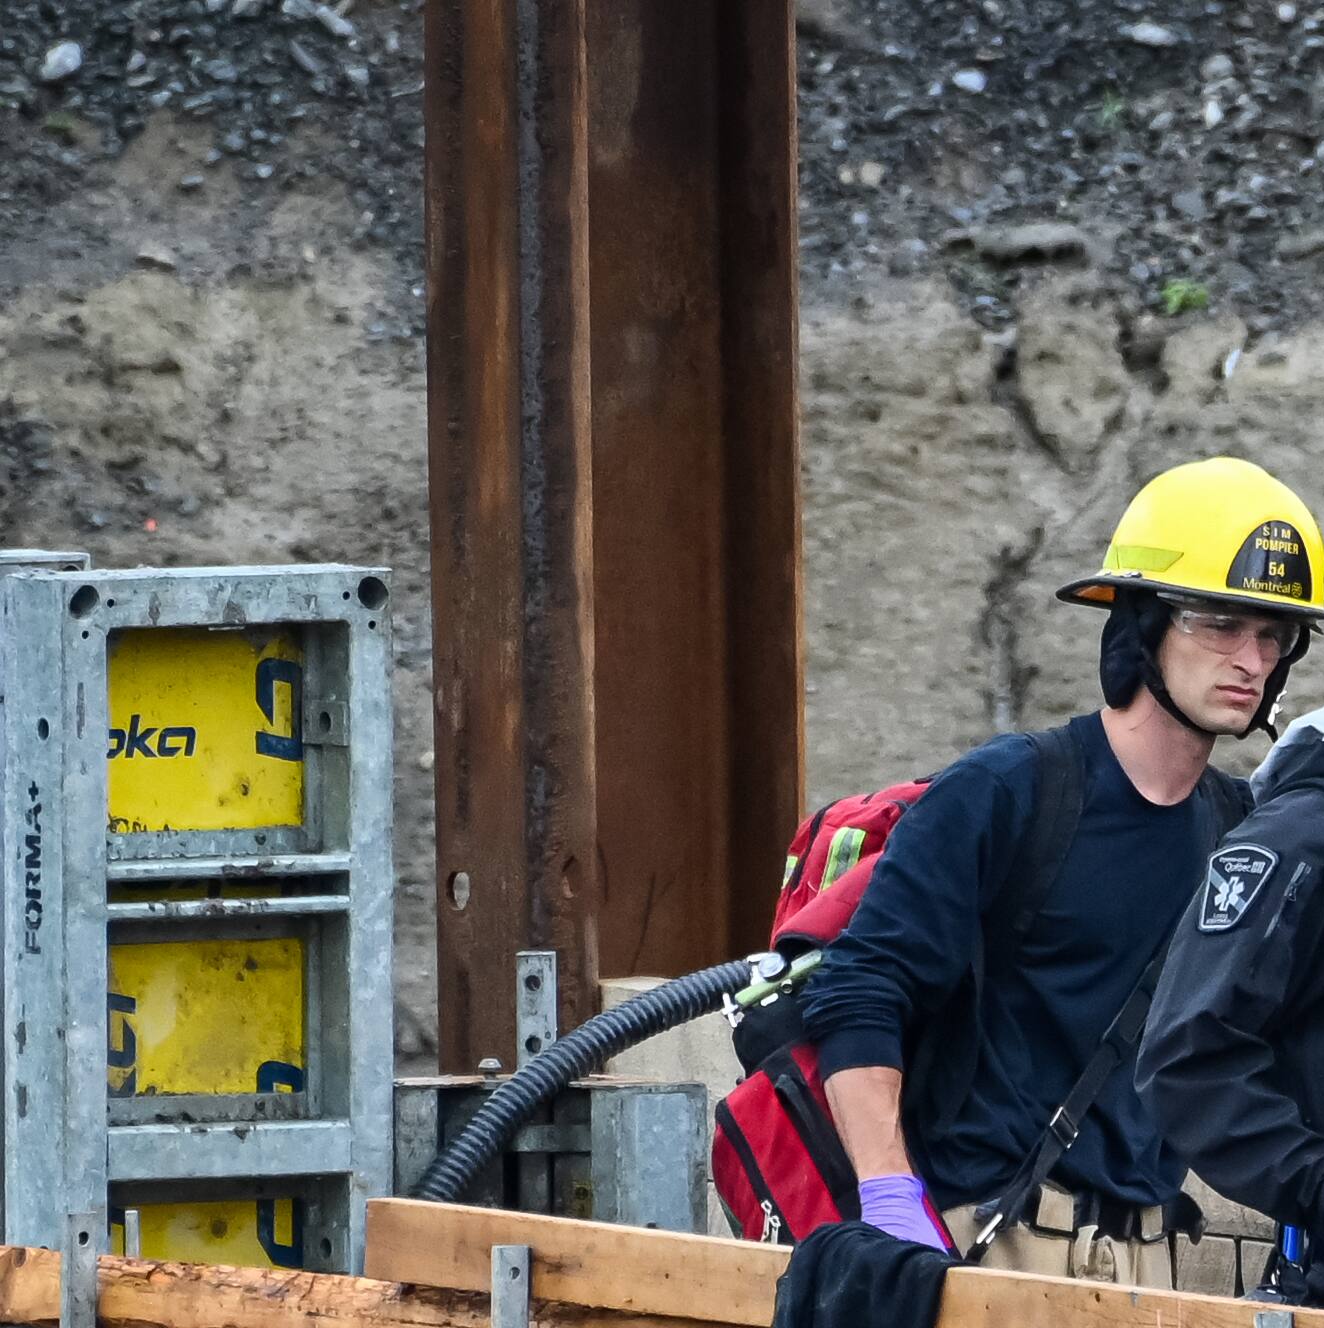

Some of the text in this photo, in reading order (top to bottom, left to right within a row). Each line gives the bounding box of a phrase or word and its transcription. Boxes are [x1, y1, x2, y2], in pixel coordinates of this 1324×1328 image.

[1255, 538, 1299, 555] POMPIER
[1243, 577, 1291, 593] Montréal
[25, 781, 43, 954] FORMA+
